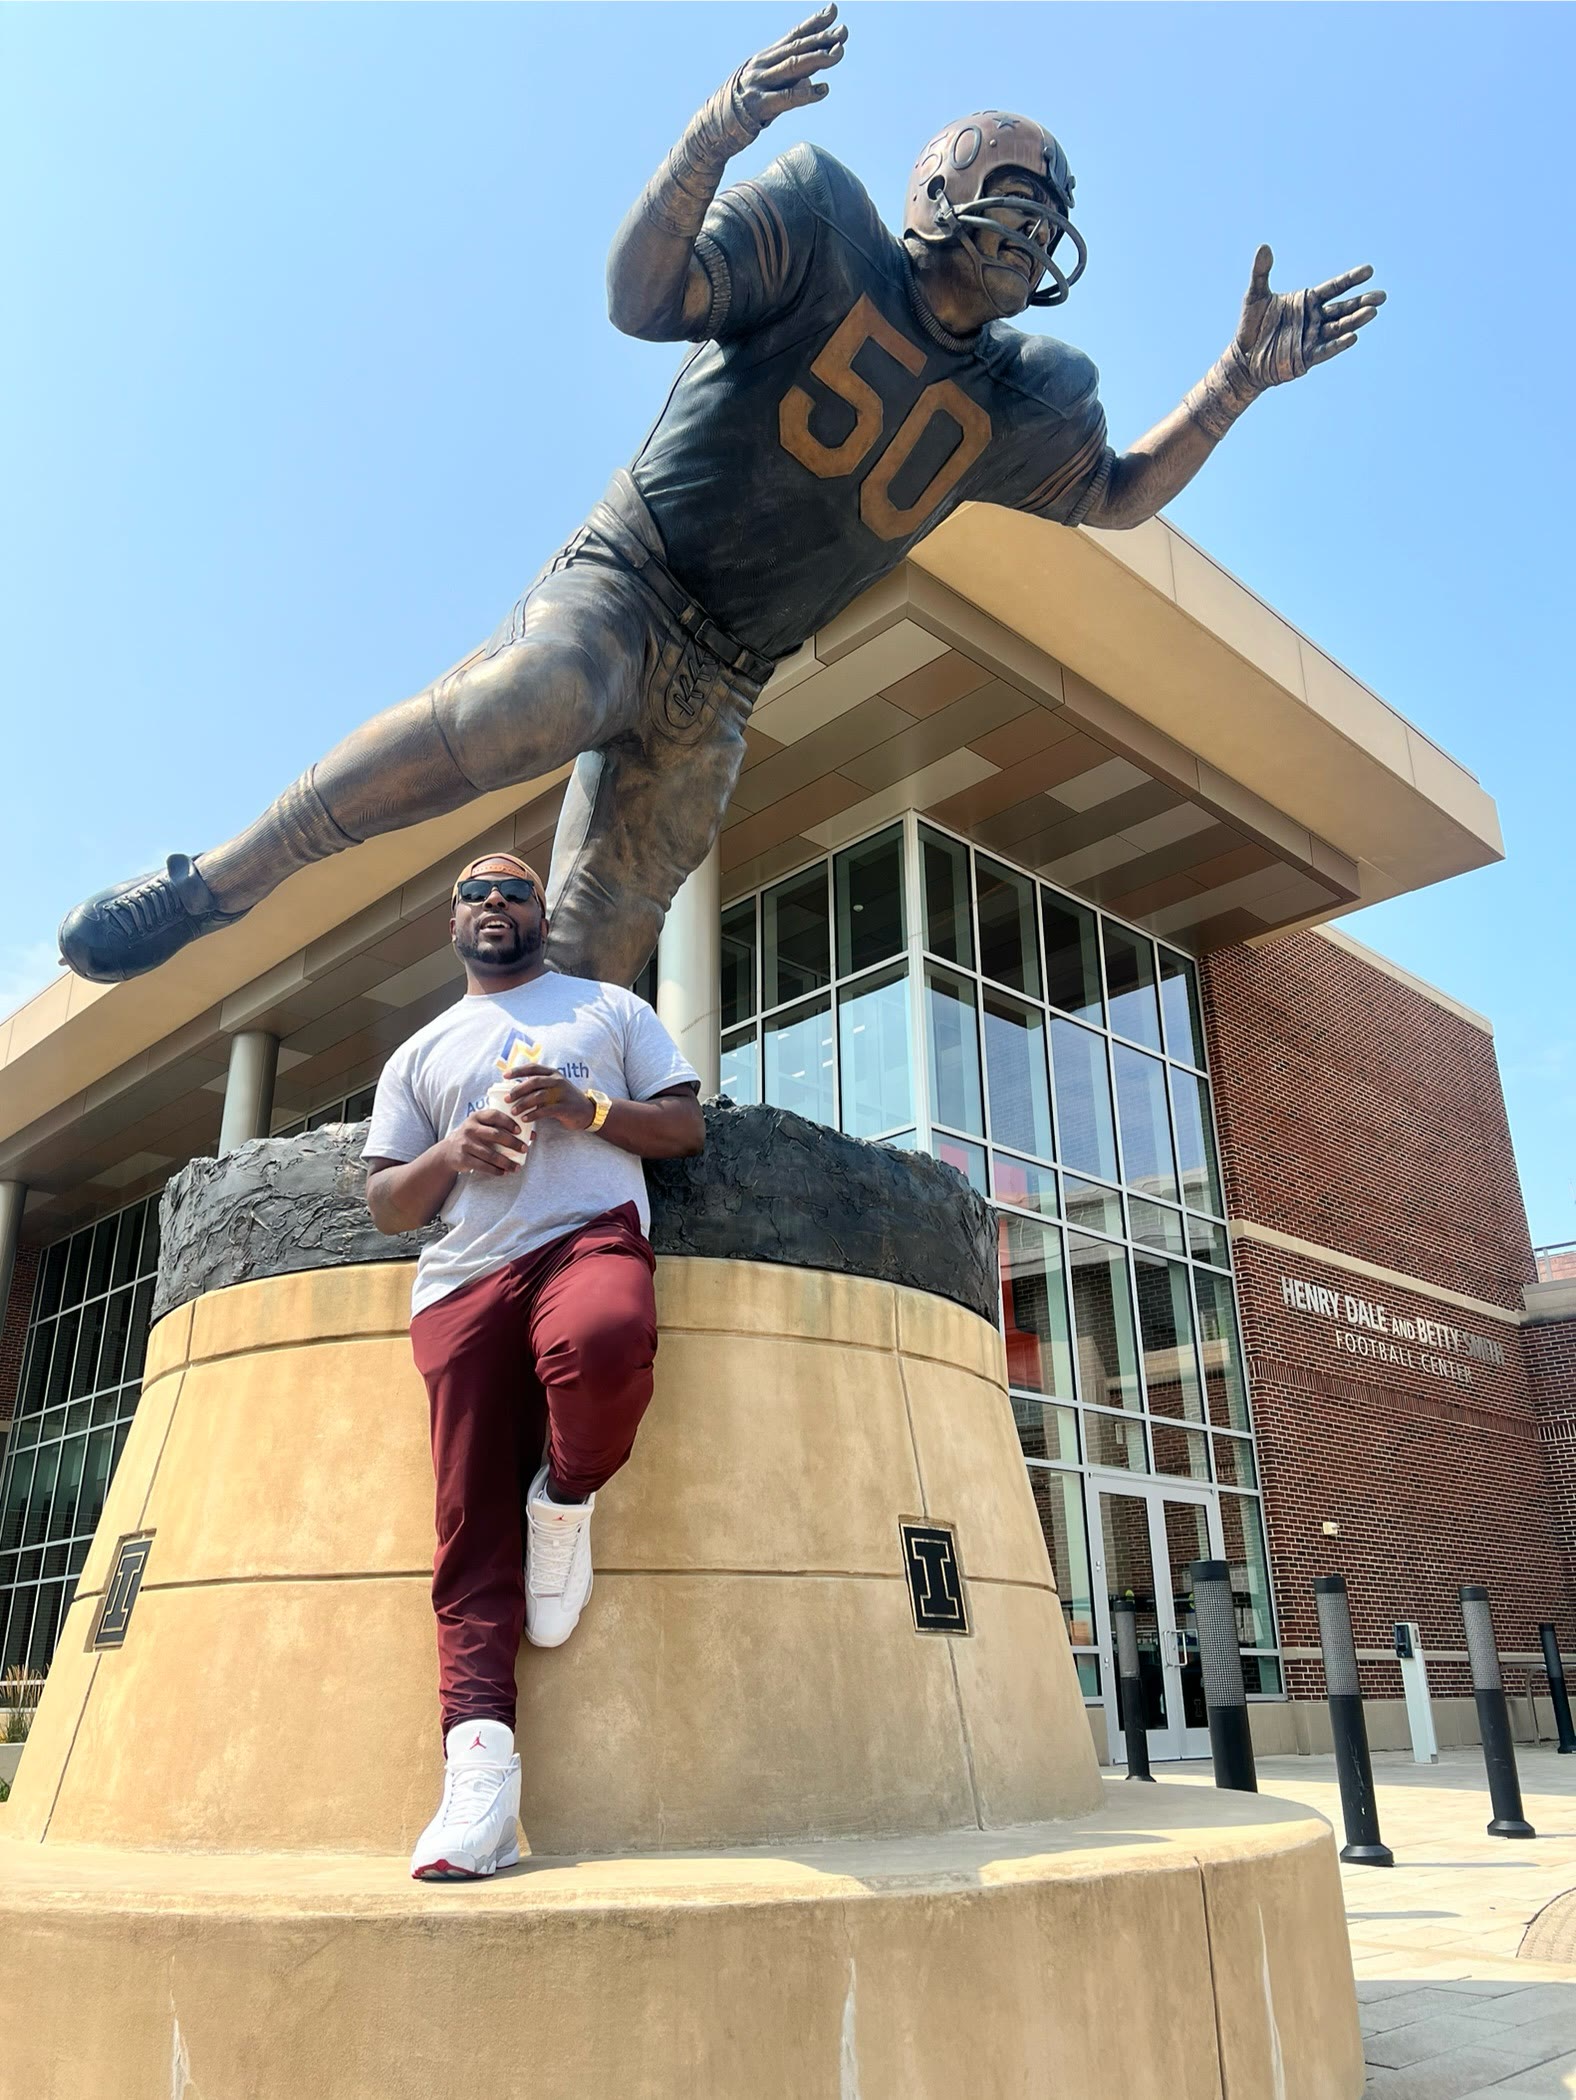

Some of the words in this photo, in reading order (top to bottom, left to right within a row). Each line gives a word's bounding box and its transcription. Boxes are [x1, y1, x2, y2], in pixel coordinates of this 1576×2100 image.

[779, 291, 993, 541] 50
[1280, 1276, 1340, 1319] HENRY
[1344, 1295, 1389, 1333] DALE
[1392, 1317, 1416, 1340] AND
[1416, 1317, 1460, 1353] BETTY
[1462, 1331, 1505, 1366] SMITH
[1335, 1330, 1415, 1368] FOOTBALL
[1421, 1353, 1474, 1384] CENTER
[100, 1550, 146, 1633] I
[911, 1537, 960, 1619] I
